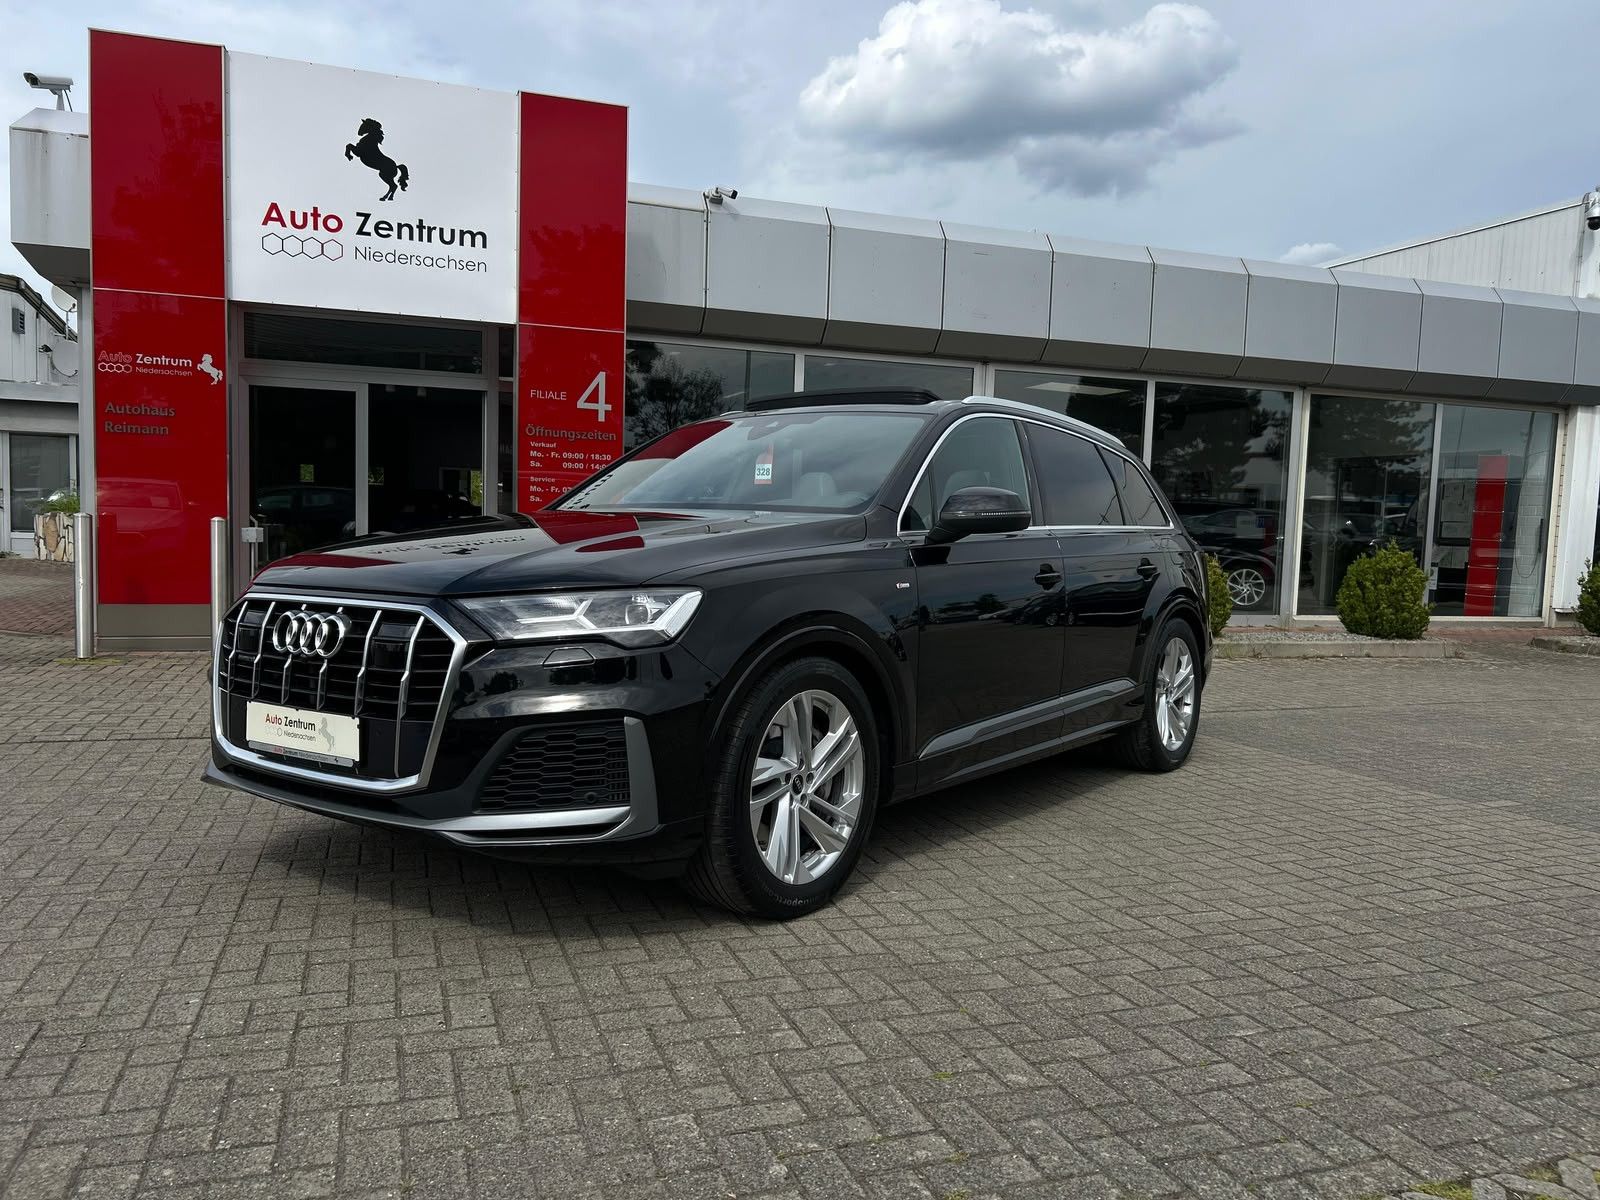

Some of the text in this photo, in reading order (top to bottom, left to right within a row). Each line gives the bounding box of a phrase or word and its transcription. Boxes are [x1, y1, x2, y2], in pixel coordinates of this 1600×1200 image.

[262, 202, 488, 249] Auto Zentrum
[354, 246, 487, 272] Niedersachsen
[98, 350, 192, 367] Auto Zentrum
[135, 366, 192, 376] Niedersachsen
[530, 389, 567, 401] FILIALE
[576, 371, 612, 422] 4
[105, 402, 176, 417] Autohaus
[104, 421, 169, 435] Reimann
[525, 424, 617, 441] Öffnungszeiten
[562, 452, 584, 460] 09:00
[756, 468, 770, 476] 328
[265, 713, 316, 731] Auto Zentrum
